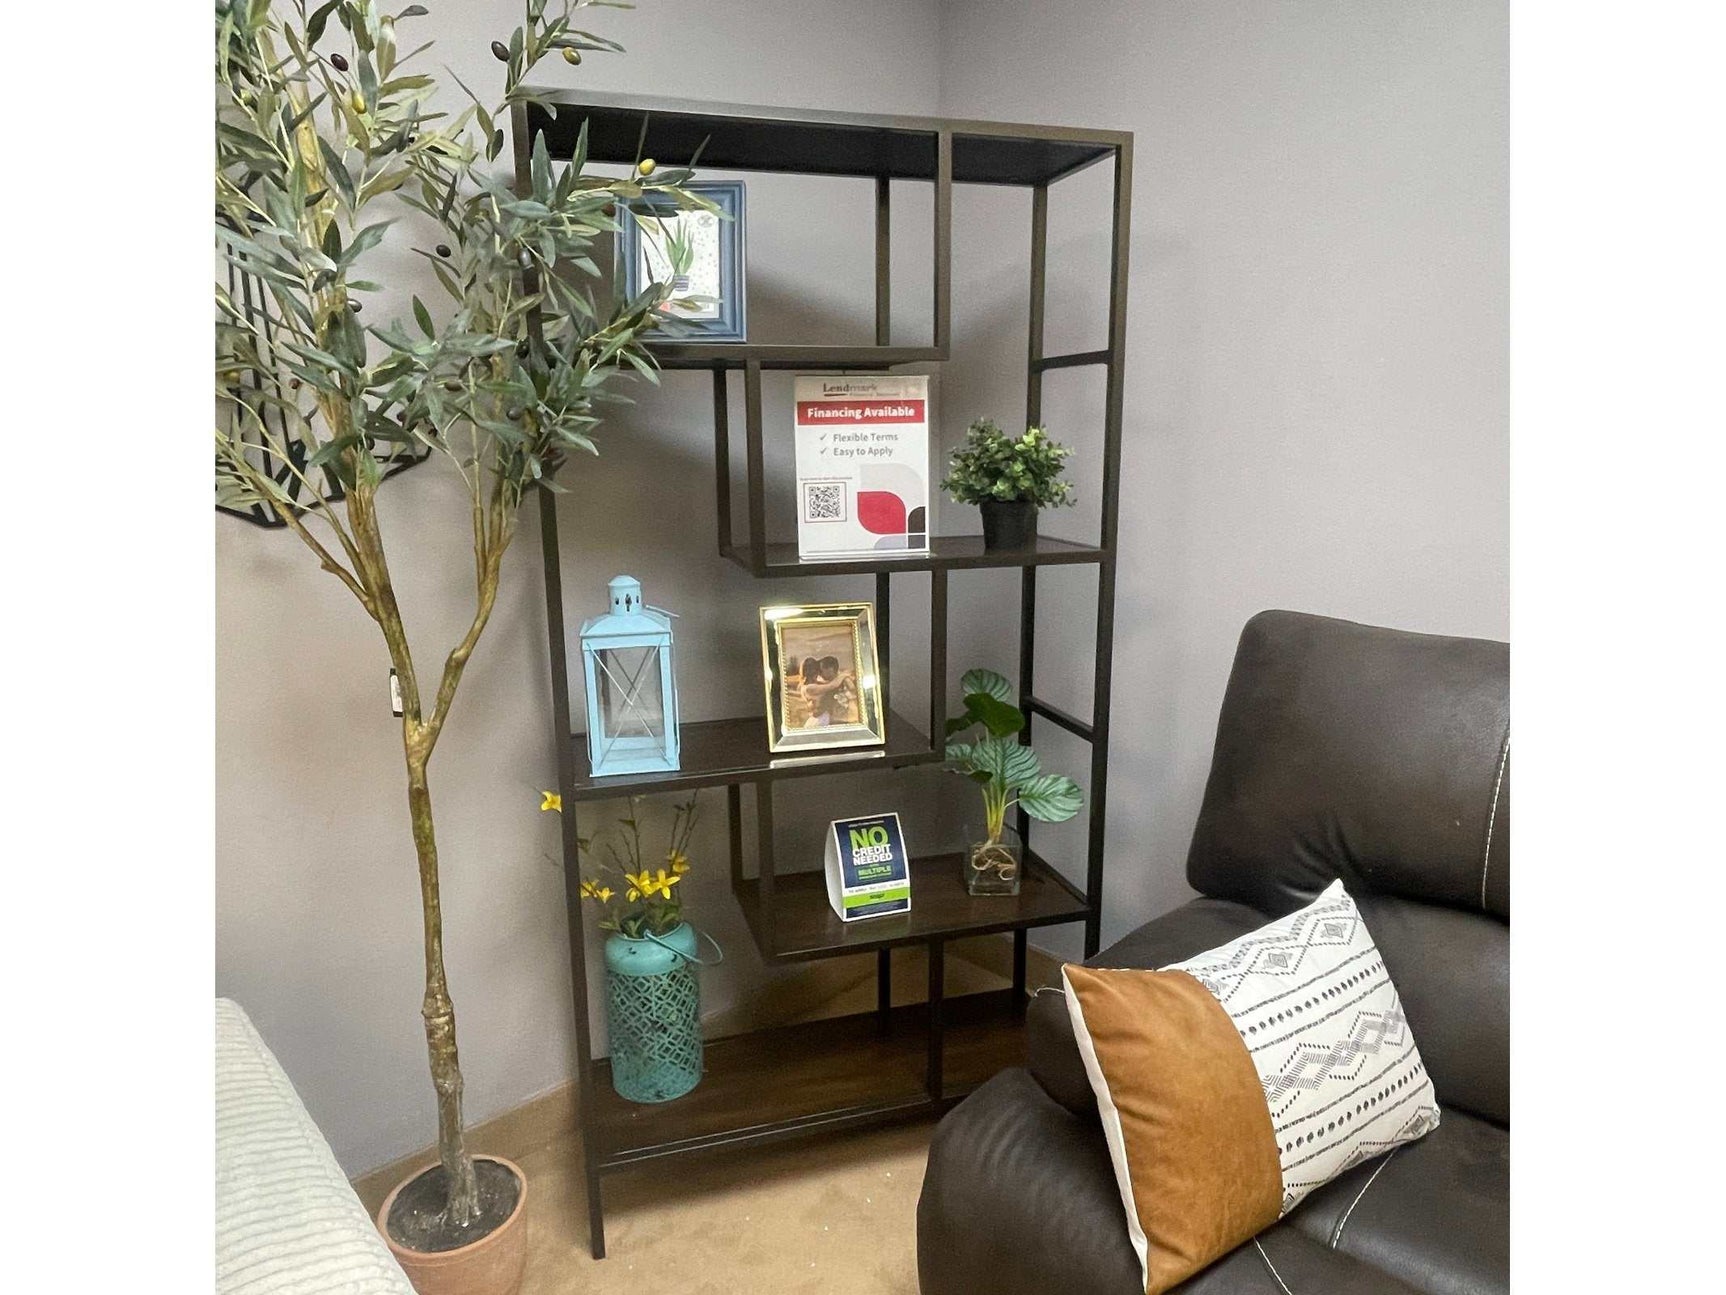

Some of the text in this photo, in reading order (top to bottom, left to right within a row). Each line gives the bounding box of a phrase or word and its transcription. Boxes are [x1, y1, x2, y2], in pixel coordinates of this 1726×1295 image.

[807, 406, 915, 420] Financing Available
[833, 432, 899, 442] Flexible Terms
[833, 446, 893, 457] Easy to Apply
[849, 826, 889, 850] NO
[852, 844, 891, 857] CREDIT
[853, 853, 893, 866] NEEDED
